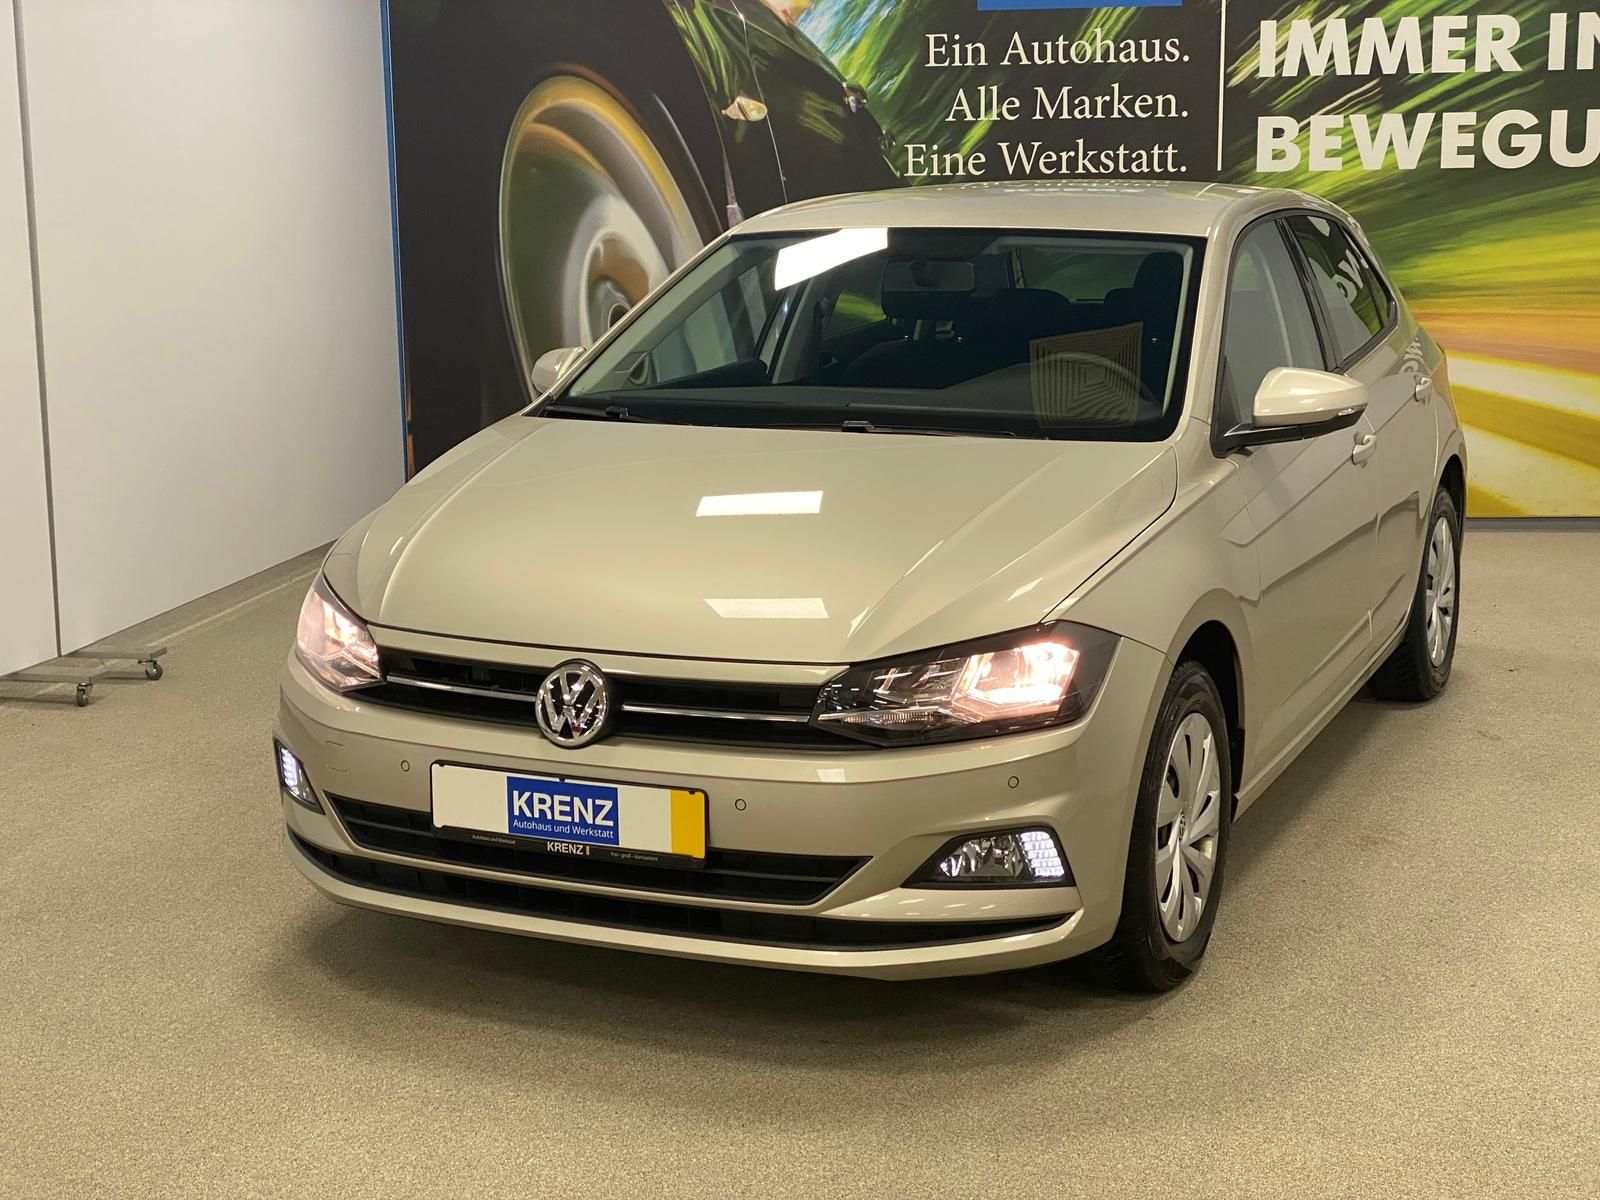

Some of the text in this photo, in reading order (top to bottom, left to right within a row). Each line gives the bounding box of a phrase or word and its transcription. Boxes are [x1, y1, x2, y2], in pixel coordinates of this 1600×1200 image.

[924, 27, 1190, 69] Ein Autohaus.
[1259, 14, 1523, 78] IMMER
[945, 83, 1189, 122] Alle Marken.
[904, 139, 1188, 178] Eine Werkstatt.
[1256, 108, 1600, 173] BEWEGU
[512, 790, 614, 827] KRENZ
[512, 819, 614, 839] Autohaus und Werkstatt
[547, 841, 584, 856] KRENZ
